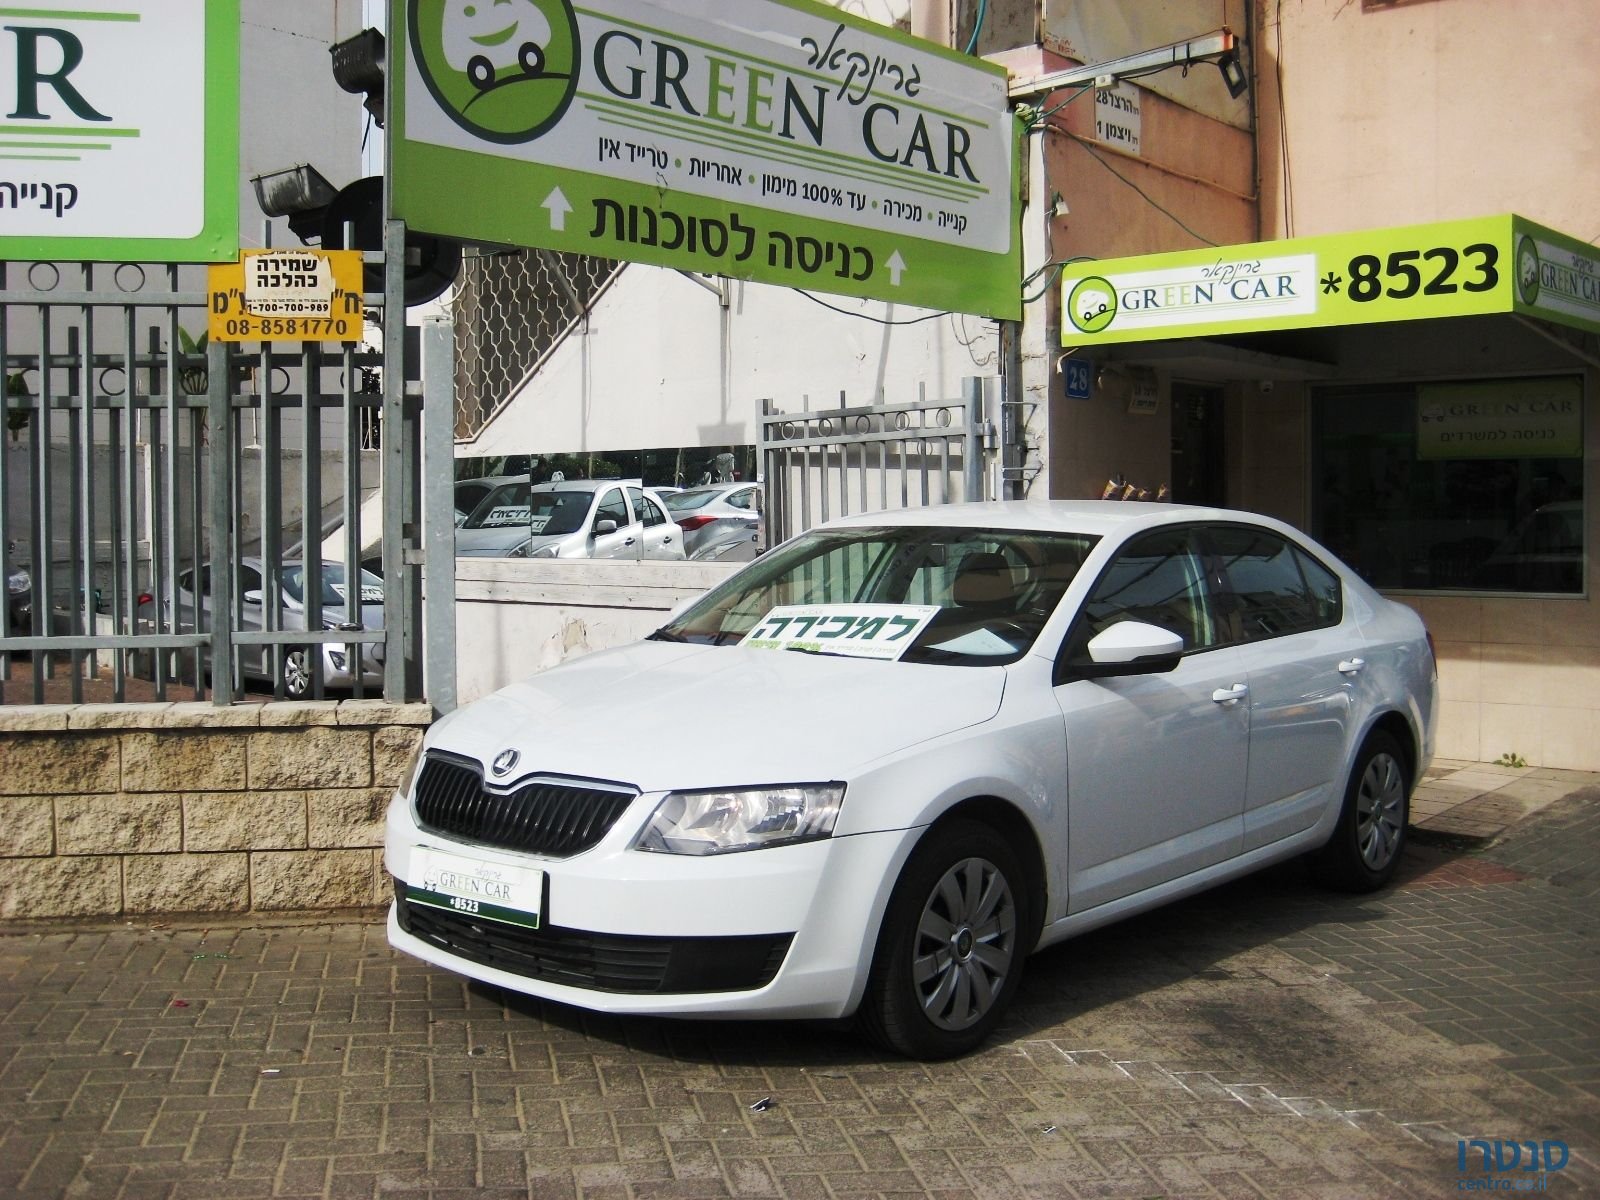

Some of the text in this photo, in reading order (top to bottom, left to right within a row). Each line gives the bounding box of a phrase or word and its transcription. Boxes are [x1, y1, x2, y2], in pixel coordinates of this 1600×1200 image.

[801, 23, 921, 106] גרינקאר
[593, 30, 981, 183] GREEN CAR
[1105, 123, 1131, 142] ויצמן
[599, 137, 968, 235] קנייה מכירה עד 100% מימון אחריות טרייד אין
[0, 182, 78, 218] קנייה
[589, 198, 874, 282] כניסה לסוכנות
[257, 259, 318, 272] שמירה
[257, 273, 318, 288] כהלכה
[1122, 275, 1296, 311] GREEN CAR
[1541, 263, 1600, 303] GREEN CA
[247, 303, 329, 313] 1-700-700-989
[226, 319, 347, 335] 08-8581770
[1070, 366, 1088, 390] 28
[1529, 401, 1574, 414] CAR
[752, 615, 921, 641] למכירה
[440, 872, 511, 899] GREEN CAR
